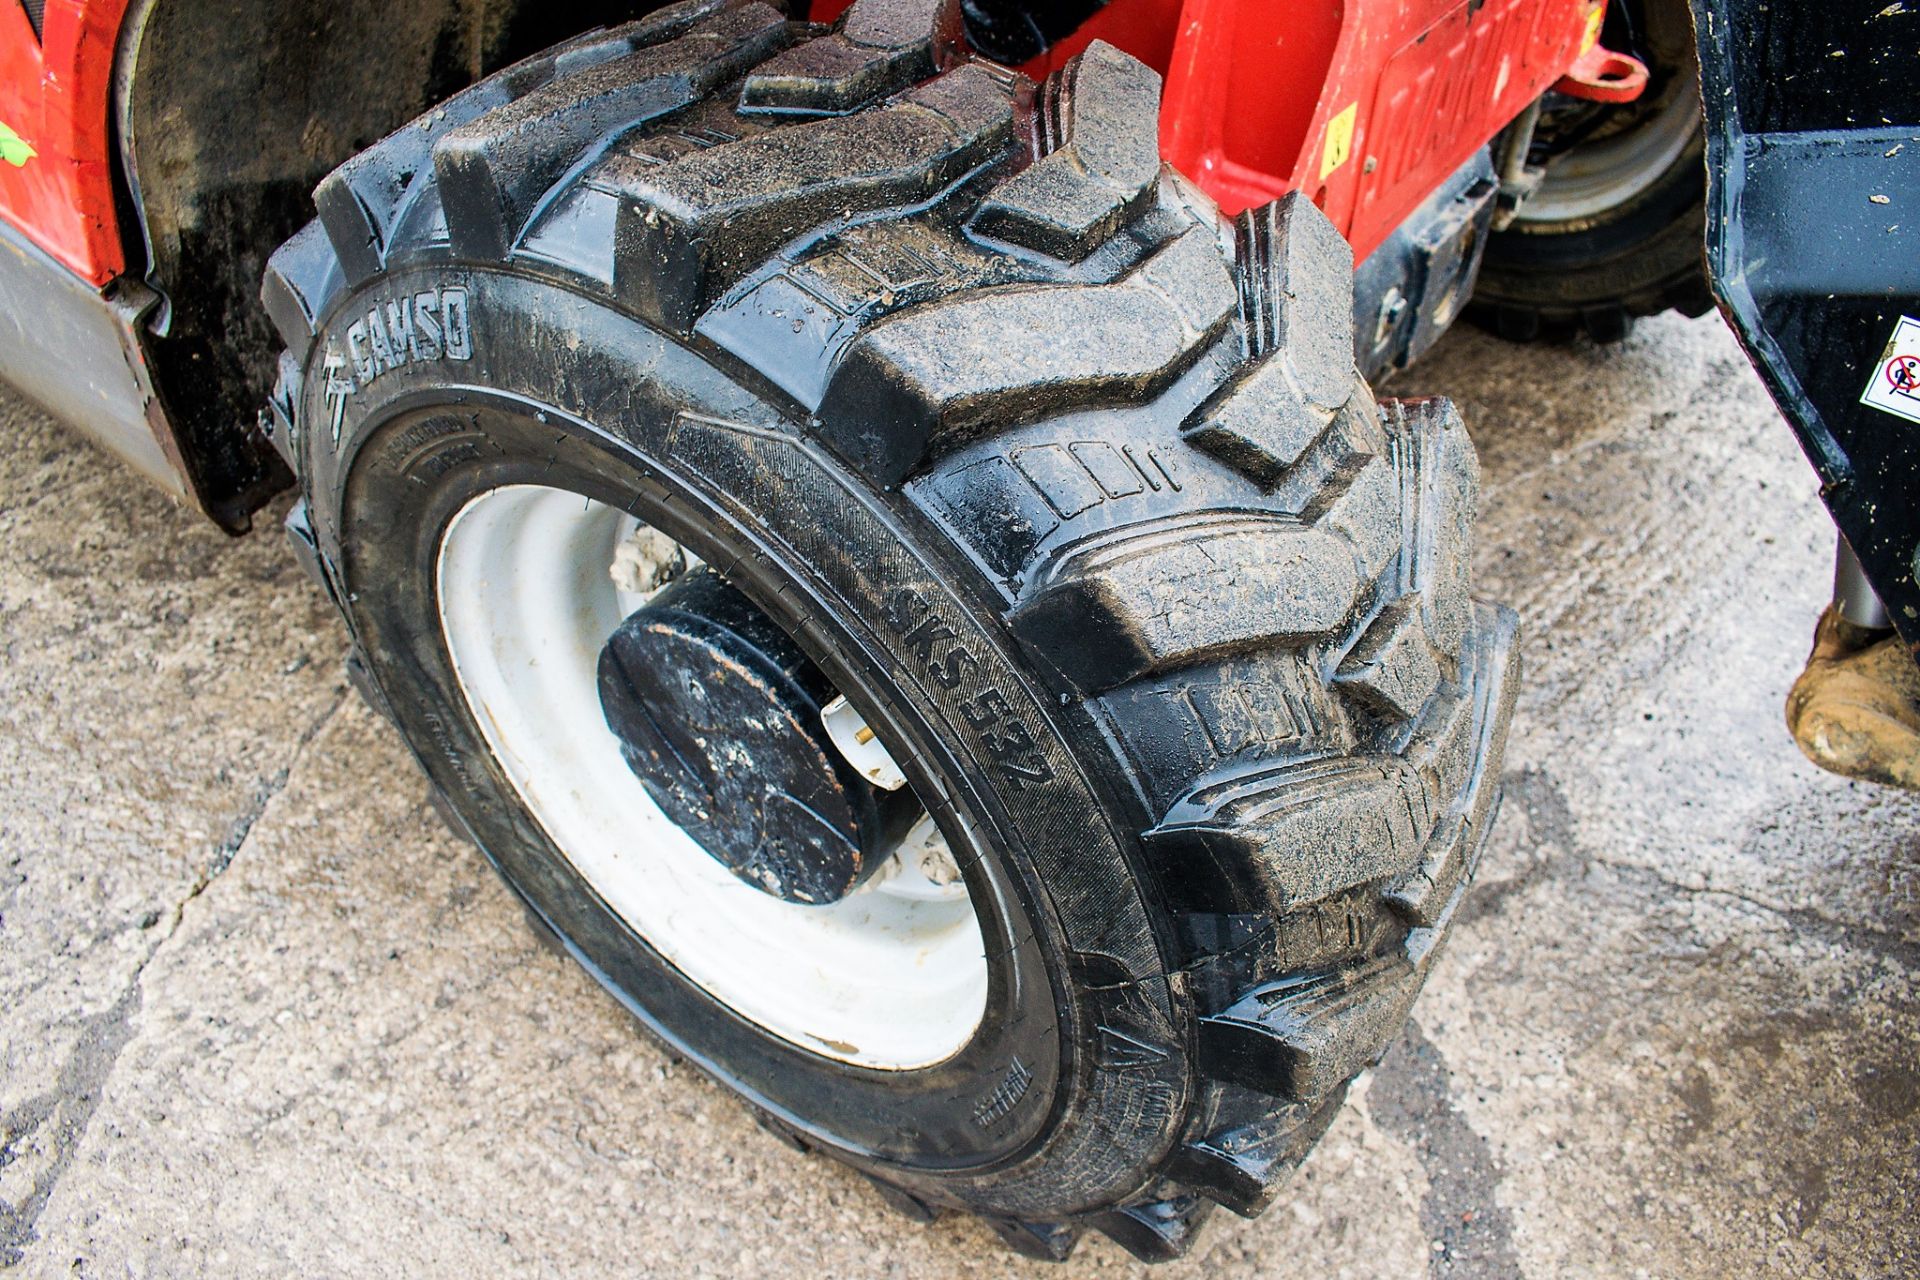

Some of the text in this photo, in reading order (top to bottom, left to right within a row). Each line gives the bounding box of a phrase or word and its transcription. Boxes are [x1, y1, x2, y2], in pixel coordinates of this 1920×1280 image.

[348, 287, 472, 384] CAMSO
[883, 589, 1056, 791] SKS 532
